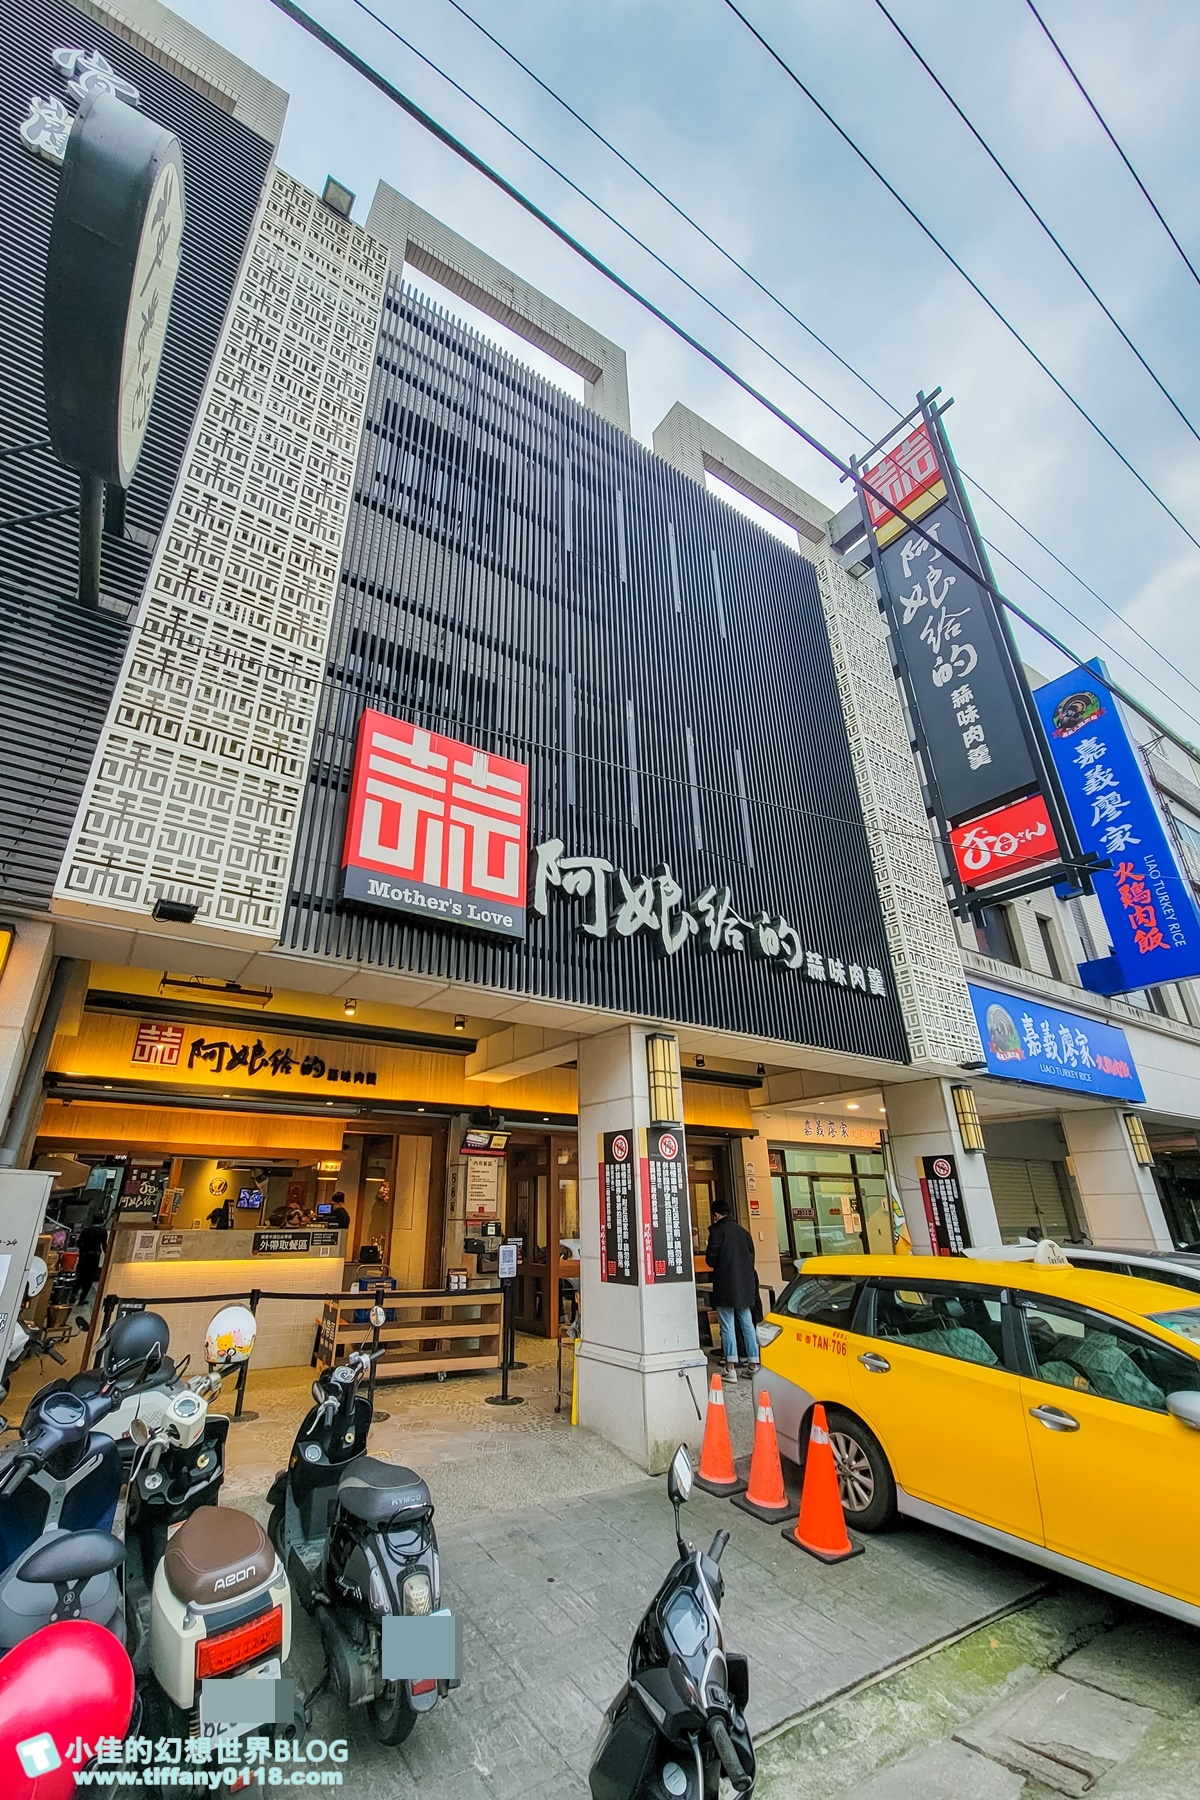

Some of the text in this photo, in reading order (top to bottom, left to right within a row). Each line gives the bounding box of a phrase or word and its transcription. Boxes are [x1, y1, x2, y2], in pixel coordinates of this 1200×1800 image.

[951, 683, 992, 771] 蒜味肉羹
[1072, 736, 1142, 854] 嘉義廖家
[367, 878, 513, 928] Mother's Love
[533, 837, 887, 998] 阿娘給的 蒜味肉羹
[1143, 854, 1187, 948] LIAO TURKEY RICE
[187, 1037, 326, 1078] 阿娘給的
[1020, 1012, 1097, 1069] 嘉義廖家
[1039, 1063, 1093, 1083] LIAO TURKEY RICE
[803, 1119, 850, 1138] 嘉義廖家
[259, 1239, 309, 1251] 外帶取餐區
[812, 1334, 847, 1356] TAN-706
[391, 1494, 422, 1506] KYMCO
